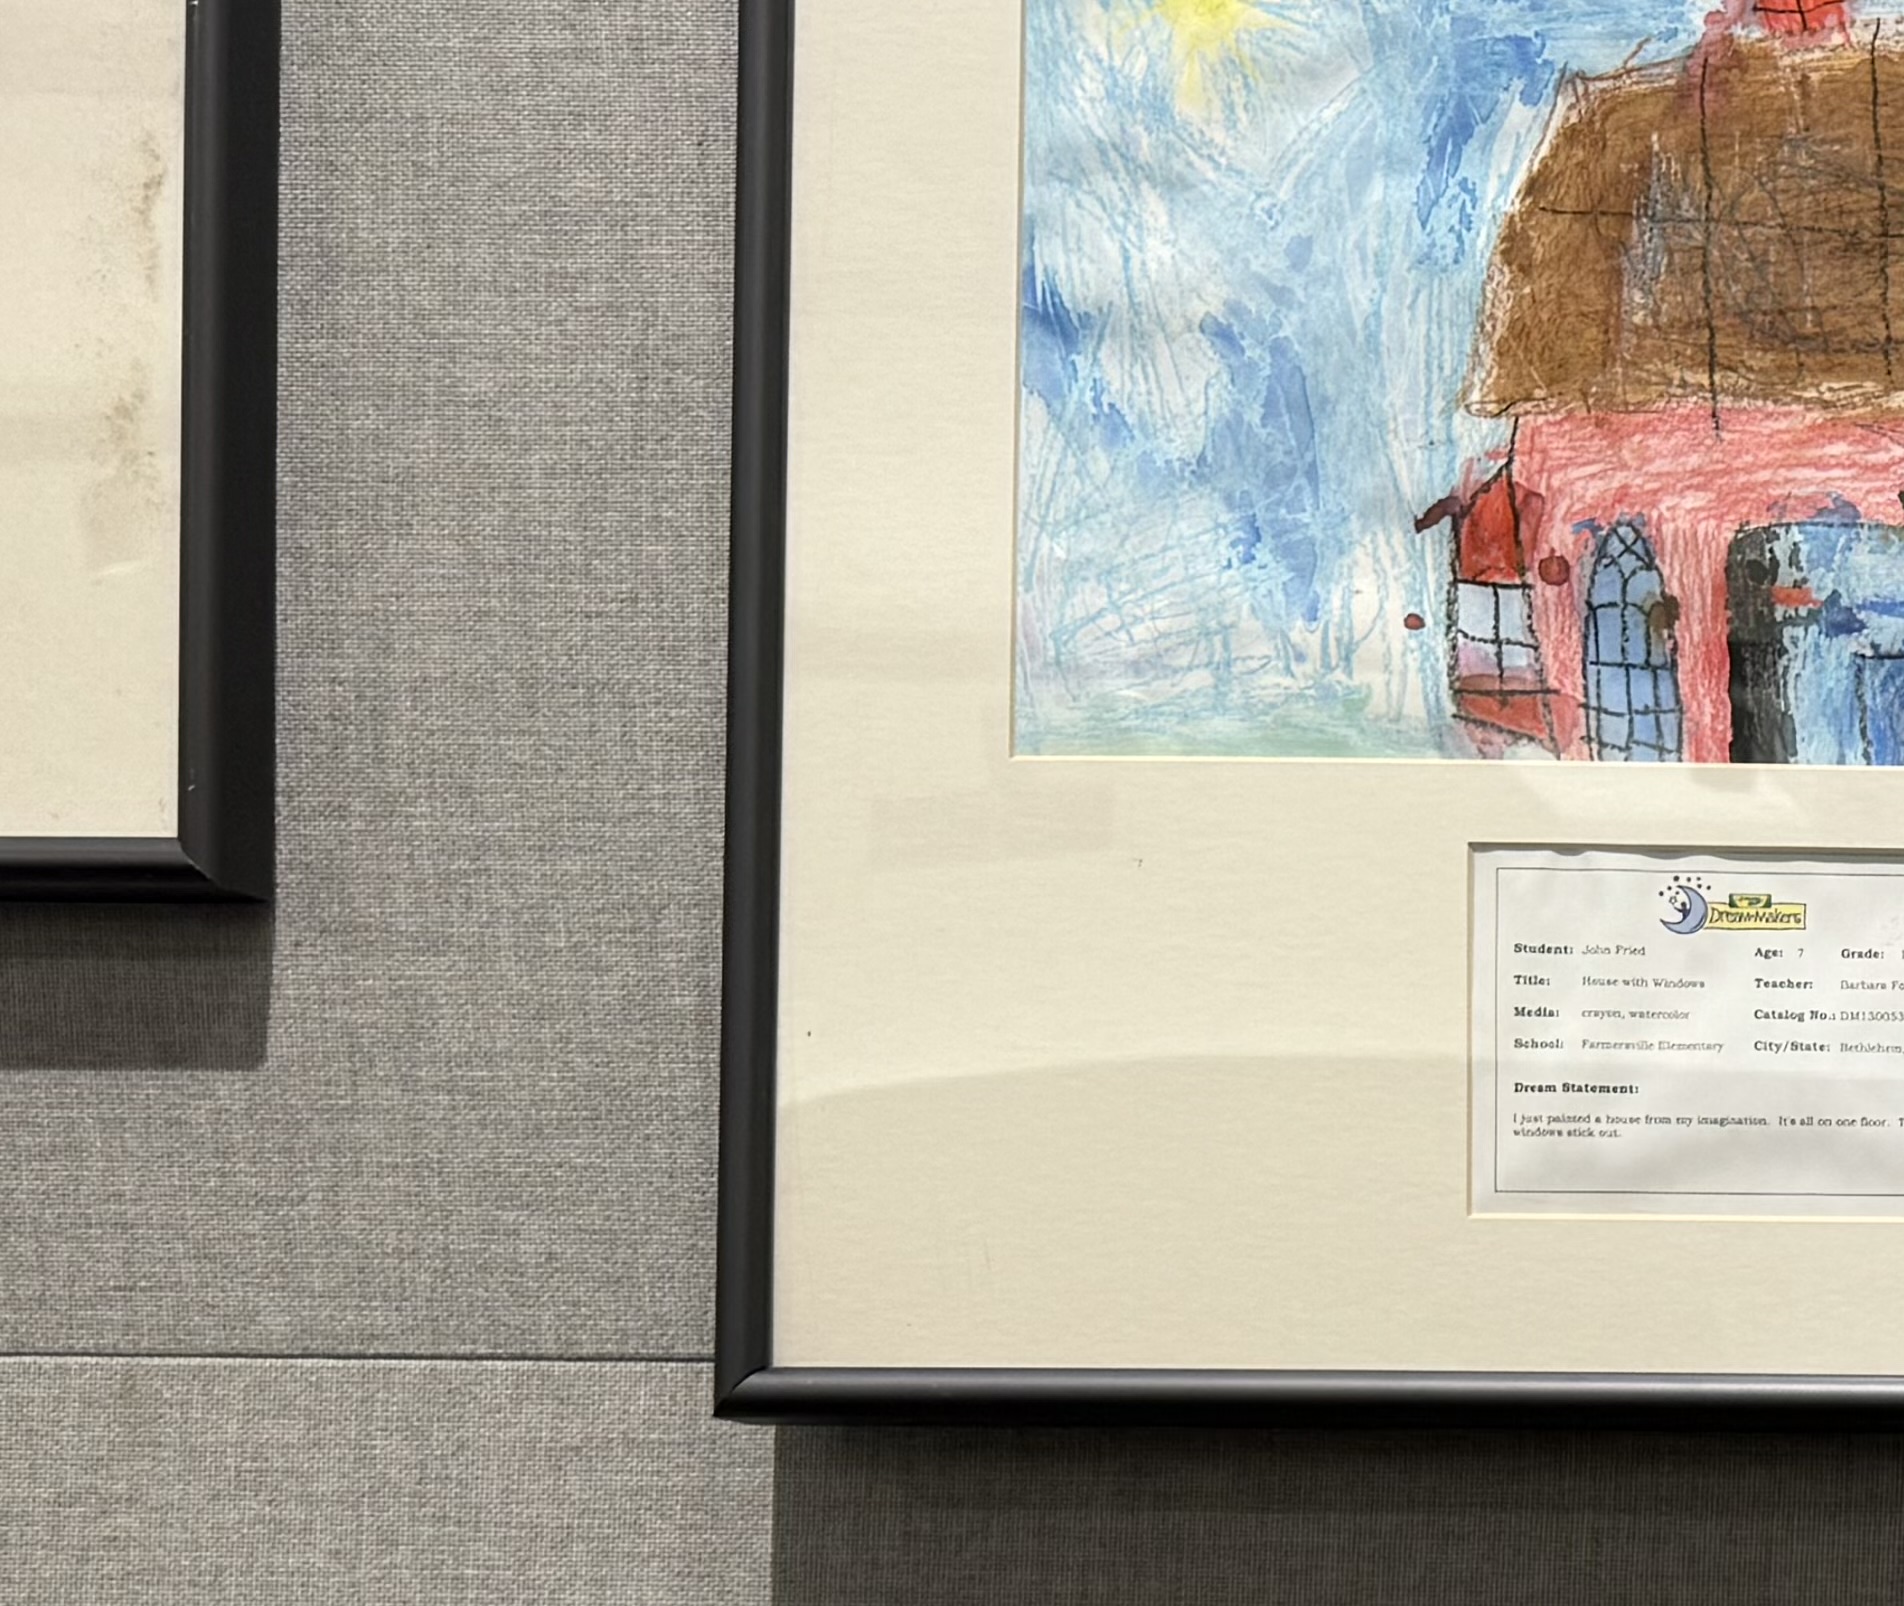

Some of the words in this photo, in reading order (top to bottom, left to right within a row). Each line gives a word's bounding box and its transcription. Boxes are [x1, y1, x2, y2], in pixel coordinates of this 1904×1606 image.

[1514, 943, 1573, 955] Student:
[1582, 945, 1611, 956] John
[1755, 948, 1783, 960] Age:
[1797, 948, 1804, 958] 7
[1841, 949, 1884, 960] Grade:
[1513, 975, 1551, 986] Title:
[1582, 976, 1619, 987] House
[1622, 977, 1648, 988] with
[1653, 978, 1705, 988] Windows
[1754, 978, 1813, 989] Teacher:
[1841, 980, 1887, 990] Barbara
[1514, 1007, 1560, 1018] Media:
[1582, 1010, 1625, 1020] crayon,
[1629, 1010, 1690, 1020] watercolor
[1754, 1010, 1805, 1022] Catalog
[1514, 1038, 1564, 1049] School:
[1658, 1040, 1724, 1053] Elementary
[1754, 1041, 1831, 1054] City/State:
[1514, 1083, 1557, 1093] Dream
[1562, 1083, 1639, 1094] Statement:
[1520, 1114, 1543, 1126] just
[1547, 1114, 1591, 1126] painted
[1606, 1115, 1641, 1125] house
[1645, 1115, 1671, 1125] from
[1676, 1117, 1693, 1127] my
[1698, 1115, 1770, 1128] imagination.
[1778, 1116, 1796, 1126] It's
[1800, 1116, 1813, 1126] all
[1818, 1118, 1832, 1127] on
[1836, 1118, 1857, 1127] one
[1861, 1117, 1890, 1127] floor.
[1513, 1127, 1563, 1138] windows
[1567, 1127, 1595, 1138] stick
